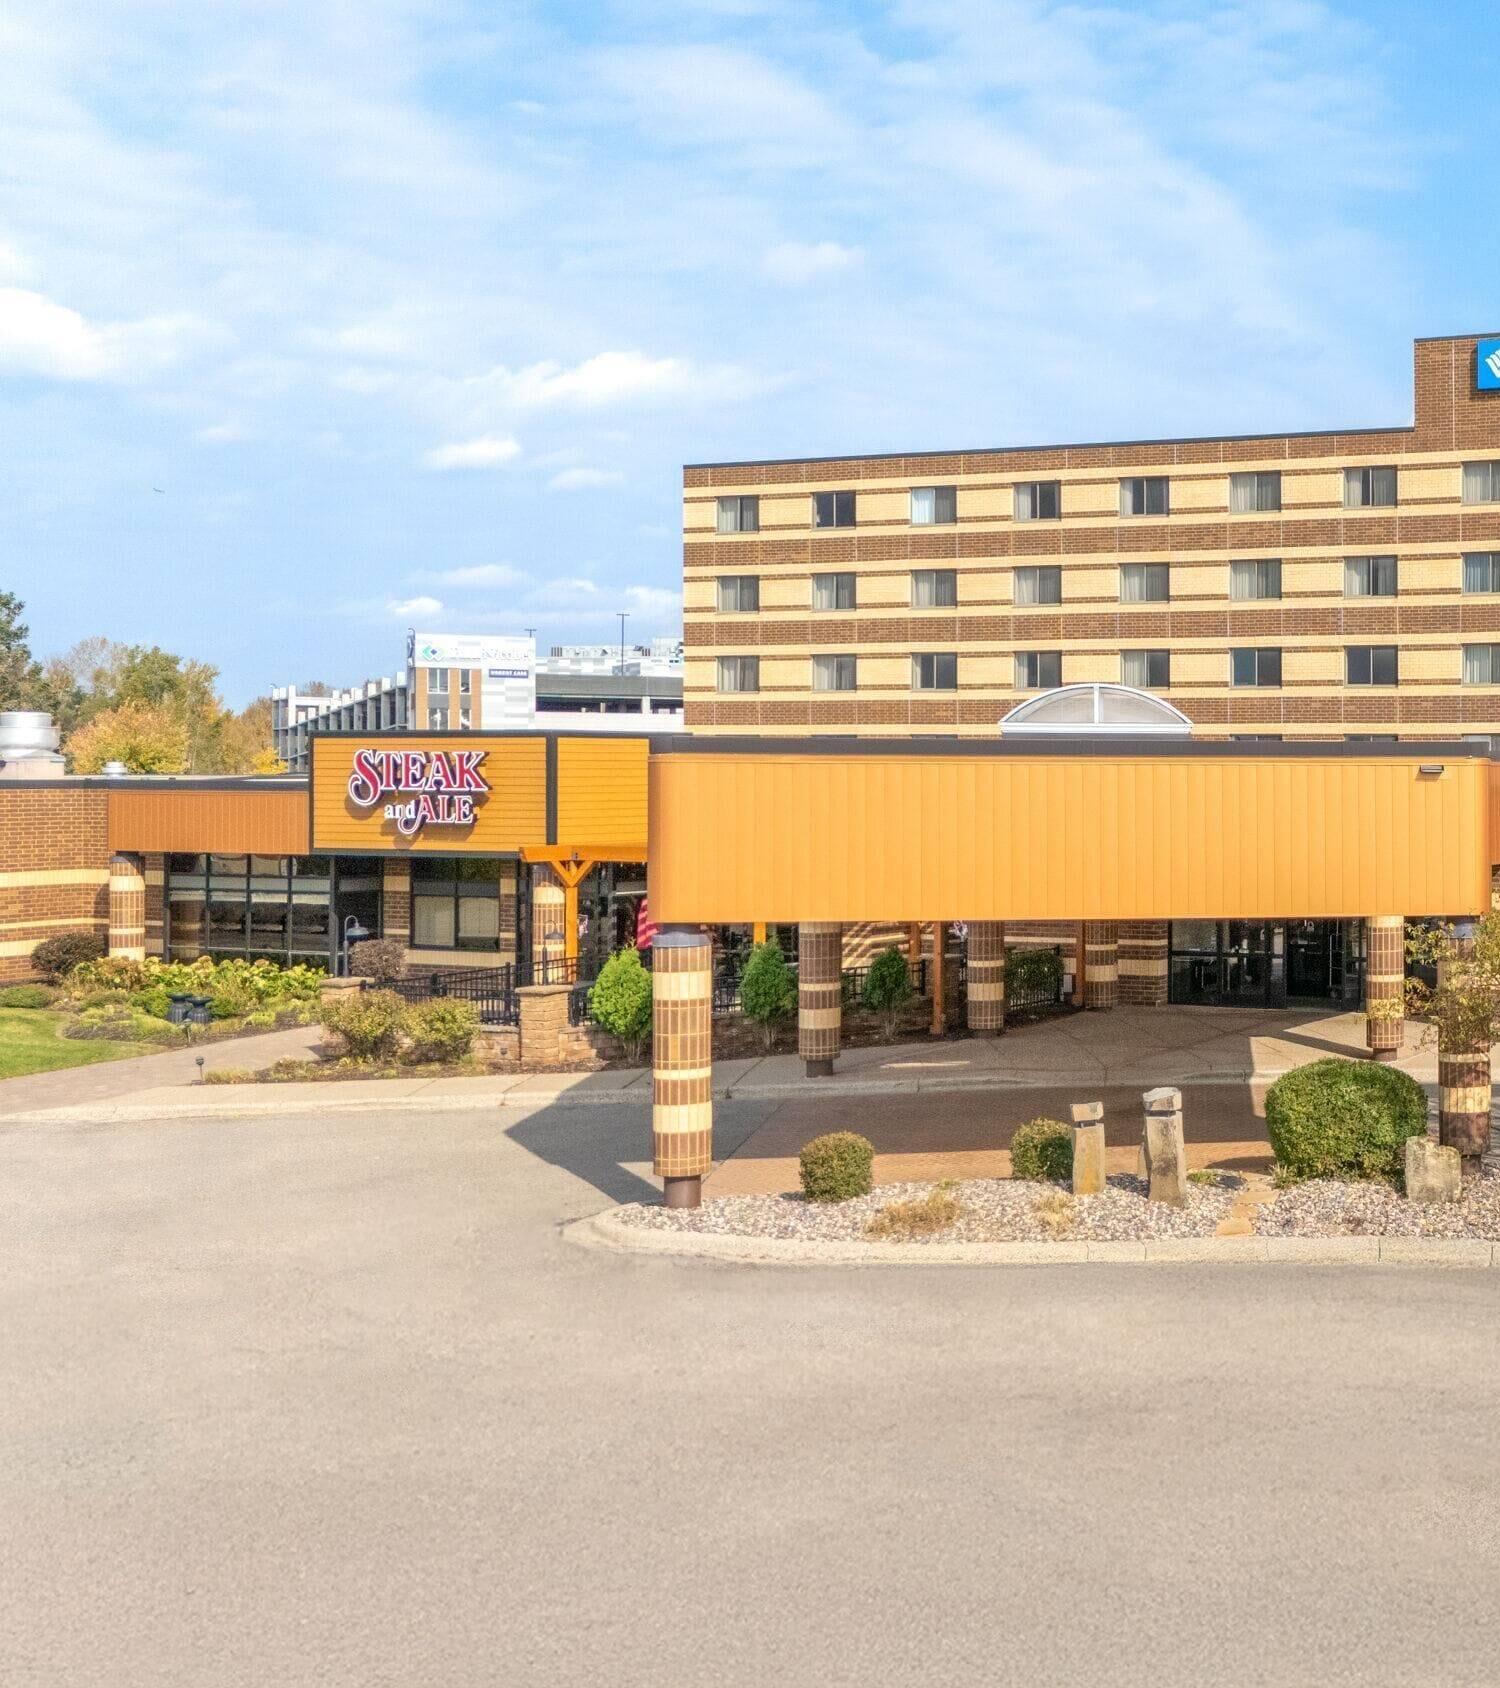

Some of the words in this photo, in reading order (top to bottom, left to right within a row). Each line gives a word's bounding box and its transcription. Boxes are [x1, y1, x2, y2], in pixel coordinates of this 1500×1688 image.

[348, 749, 488, 805] STEAK
[384, 800, 416, 819] and
[398, 795, 474, 834] ALE
